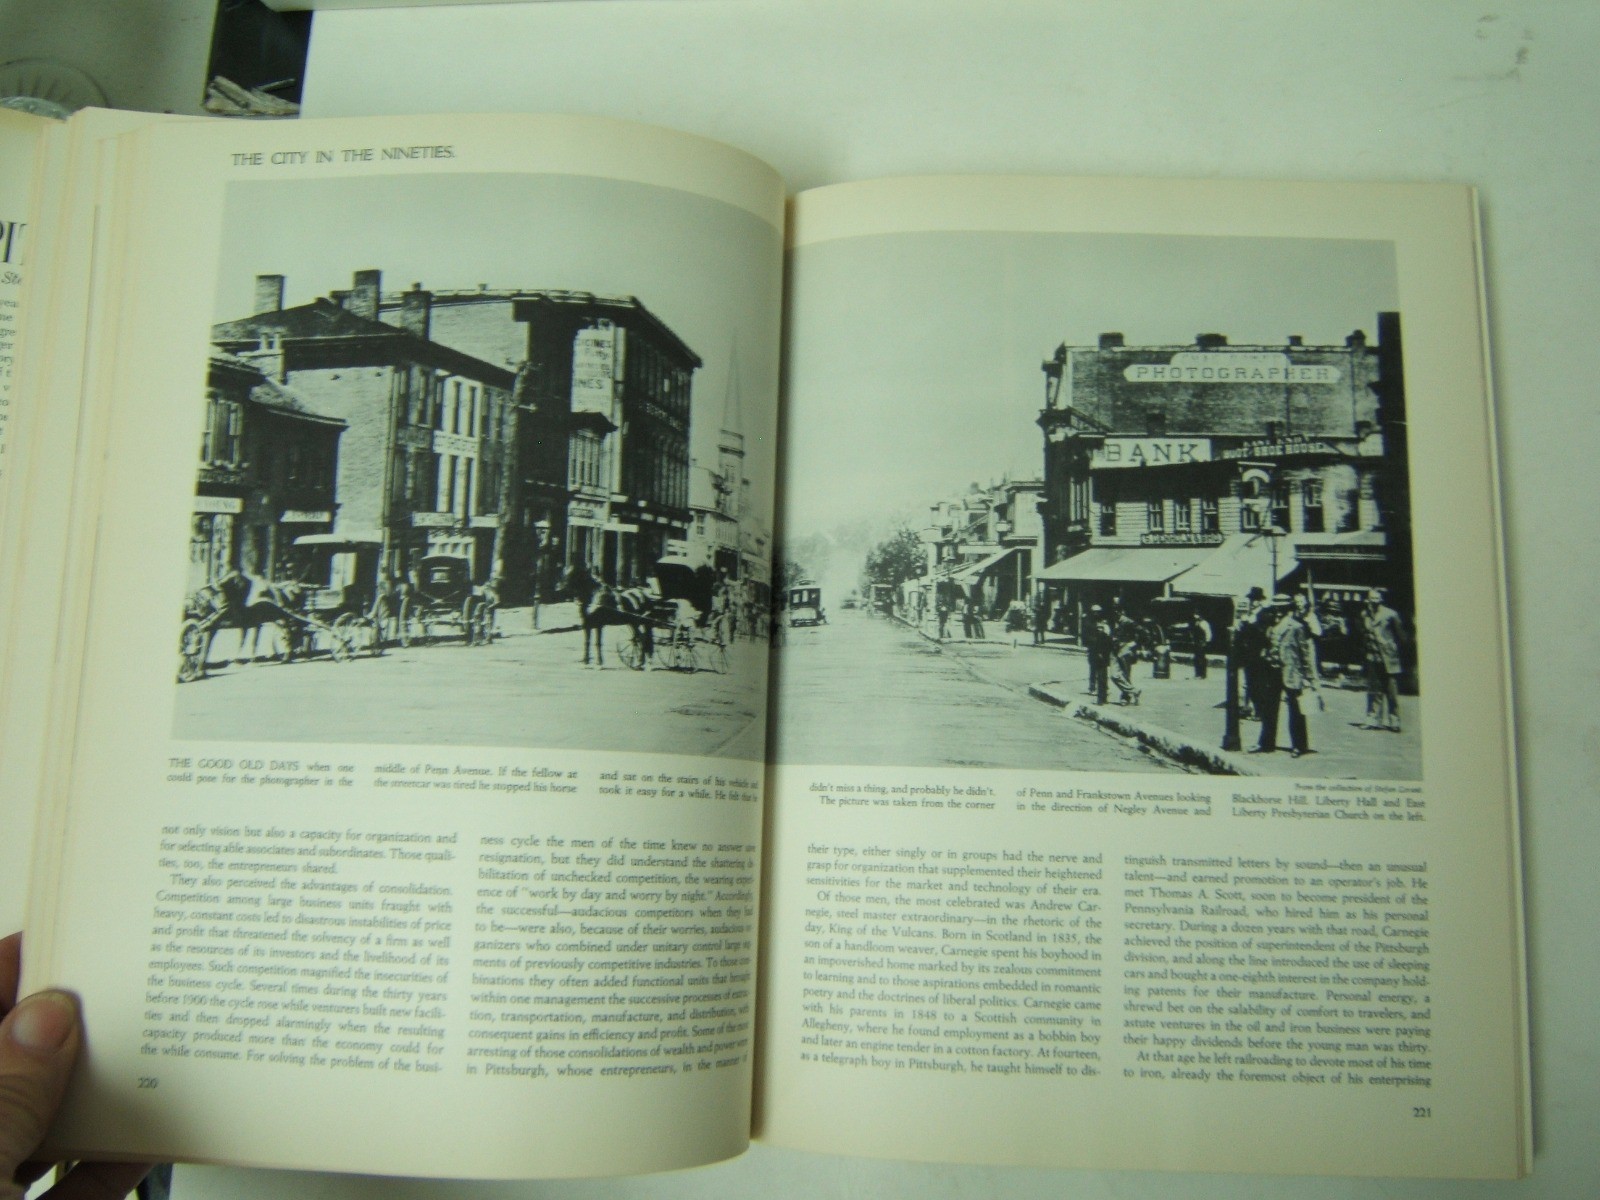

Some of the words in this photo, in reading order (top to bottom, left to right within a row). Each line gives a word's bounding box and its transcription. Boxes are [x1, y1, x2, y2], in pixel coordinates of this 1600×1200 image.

[232, 152, 263, 166] THE
[271, 151, 308, 165] CITY
[316, 150, 333, 163] IN
[343, 149, 373, 162] THE
[381, 146, 455, 161] NINETIES.
[1135, 365, 1330, 381] PHOTOGRAPHER
[169, 758, 192, 768] THE
[198, 759, 233, 769] GOOD
[239, 760, 264, 770] OLD
[270, 762, 299, 771] DAYS
[306, 762, 331, 772] when
[337, 765, 354, 773] one
[374, 762, 405, 774] middle
[410, 763, 420, 774] of
[424, 763, 448, 775] Penn
[454, 764, 491, 776] Avenue.
[498, 766, 506, 776] If
[511, 766, 526, 777] the
[532, 766, 562, 778] fellow
[567, 769, 577, 778] at
[167, 770, 192, 782] could
[196, 775, 217, 786] pose
[222, 772, 236, 783] for
[241, 773, 255, 784] the
[260, 773, 319, 789] photographer
[324, 776, 333, 786] in
[338, 775, 354, 786] the
[374, 776, 388, 787] the
[433, 781, 450, 789] was
[454, 778, 476, 790] tired
[478, 779, 489, 790] he
[493, 779, 531, 794] stopped
[533, 780, 547, 791] his
[550, 781, 576, 792] horse
[600, 769, 618, 781] and
[623, 772, 636, 782] sat
[642, 774, 652, 782] on
[658, 772, 672, 783] the
[676, 774, 699, 785] stairs
[703, 774, 711, 785] of
[714, 775, 726, 786] his
[599, 783, 620, 795] took
[626, 786, 632, 795] it
[636, 788, 656, 800] easy
[661, 786, 675, 798] for
[688, 788, 710, 800] while.
[714, 789, 726, 800] He
[810, 781, 833, 792] didn't
[836, 783, 854, 793] miss
[864, 782, 887, 797] thing,
[891, 783, 907, 794] and
[910, 783, 950, 798] probably
[952, 784, 963, 795] he
[966, 785, 995, 796] didn't.
[1017, 786, 1025, 797] of
[1029, 787, 1052, 798] Penn
[1056, 787, 1073, 798] and
[1076, 788, 1130, 800] Frankstown
[1134, 789, 1173, 801] Avenues
[1176, 790, 1210, 805] looking
[820, 794, 835, 805] The
[838, 796, 868, 809] picture
[872, 799, 889, 807] was
[892, 796, 917, 807] taken
[921, 797, 943, 808] from
[947, 798, 961, 809] the
[965, 801, 995, 810] corner
[1016, 801, 1025, 811] in
[1031, 800, 1045, 811] the
[1051, 801, 1092, 812] direction
[1098, 802, 1108, 812] of
[1113, 802, 1146, 817] Negley
[1153, 803, 1188, 814] Avenue
[1194, 804, 1211, 815] and
[162, 823, 179, 835] not
[183, 822, 205, 839] only
[210, 825, 240, 836] vision
[244, 824, 261, 837] but
[265, 825, 285, 838] also
[300, 827, 341, 843] capacity
[346, 827, 361, 840] for
[366, 829, 431, 846] organization
[436, 830, 457, 843] and
[807, 842, 828, 855] their
[833, 844, 857, 861] type,
[862, 843, 890, 856] either
[896, 844, 925, 861] singly
[930, 849, 942, 858] or
[947, 847, 956, 858] in
[962, 850, 997, 863] groups
[1002, 847, 1022, 860] had
[1027, 848, 1043, 861] the
[1048, 852, 1078, 862] nerve
[1082, 849, 1102, 862] and
[477, 888, 502, 897] ence
[506, 885, 517, 897] of
[562, 886, 576, 902] by
[580, 886, 600, 903] day
[605, 887, 626, 900] and
[630, 891, 662, 904] worry
[664, 888, 677, 904] by
[802, 999, 823, 1013] with
[828, 1001, 843, 1014] his
[850, 1003, 886, 1020] parents
[894, 1005, 903, 1017] in
[912, 1004, 936, 1018] 1848
[943, 1008, 954, 1019] to
[961, 1011, 967, 1020] a
[974, 1007, 1016, 1022] Scottish
[1024, 1011, 1083, 1029] community
[1090, 1014, 1101, 1026] in
[1123, 1067, 1133, 1078] to
[1140, 1067, 1165, 1082] iron,
[1171, 1066, 1210, 1084] already
[1216, 1068, 1233, 1081] the
[1238, 1068, 1286, 1082] foremost
[1292, 1070, 1324, 1087] object
[1331, 1071, 1341, 1084] of
[1347, 1071, 1363, 1084] his
[1368, 1073, 1431, 1090] enterprising
[1413, 1107, 1431, 1118] 221
